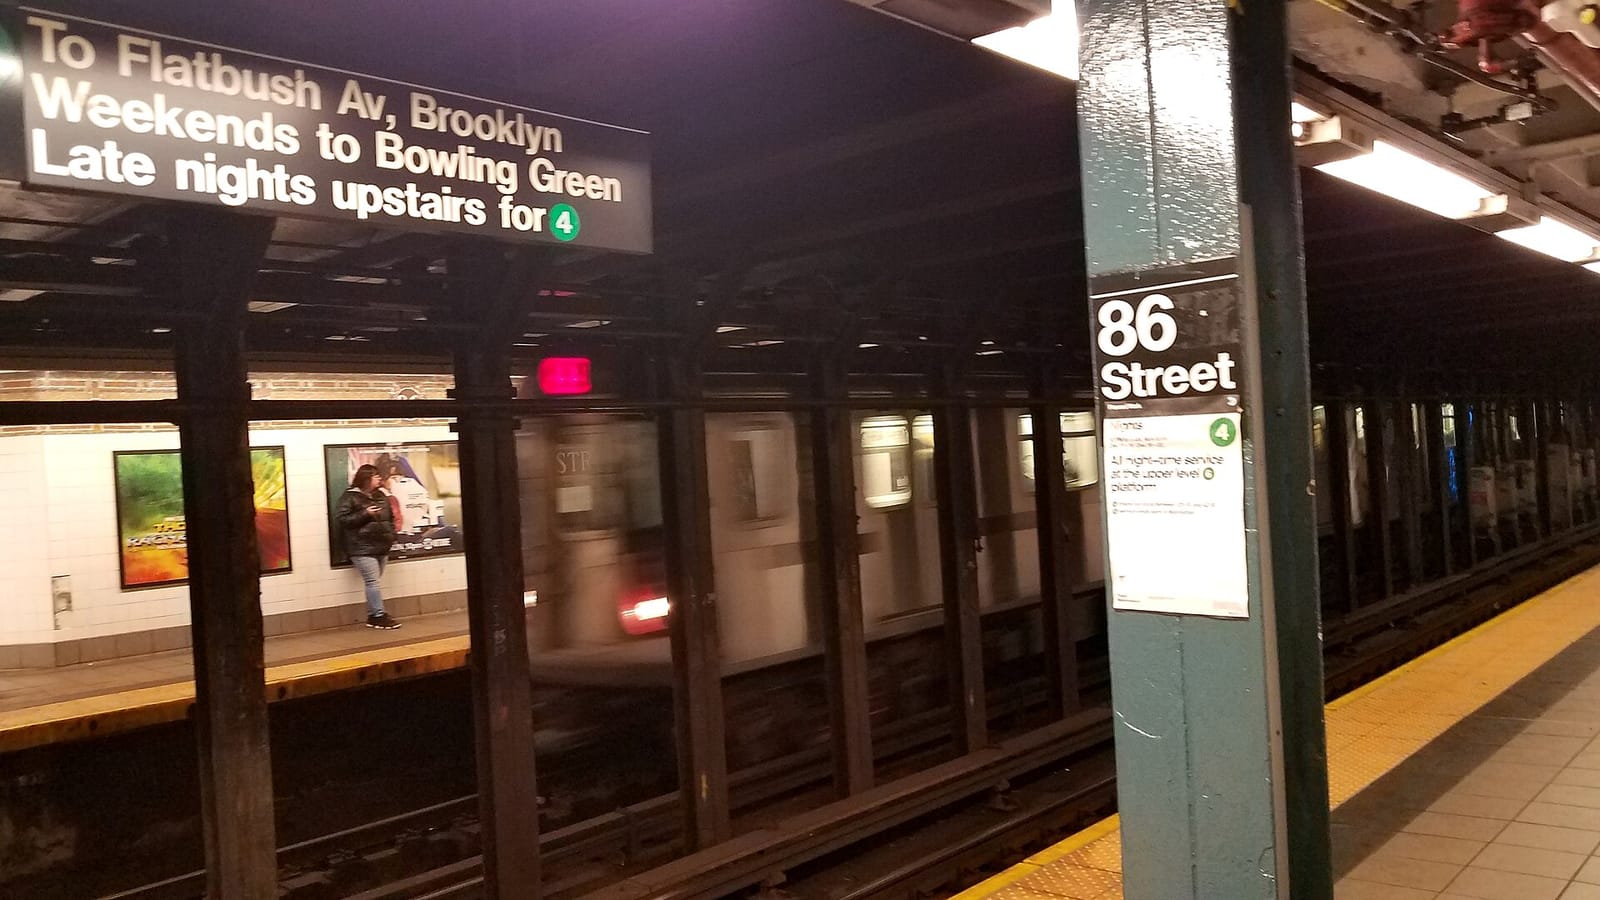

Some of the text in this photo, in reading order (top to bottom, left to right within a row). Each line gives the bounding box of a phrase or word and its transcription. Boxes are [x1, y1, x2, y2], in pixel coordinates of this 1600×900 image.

[27, 17, 562, 155] To Flatbush Av, Brooklyn
[32, 74, 622, 202] Weekends to Bowling Green
[32, 129, 574, 234] Late nights upstairs for 4
[1098, 294, 1177, 356] 86
[1101, 352, 1236, 400] Street
[1214, 423, 1231, 441] 4
